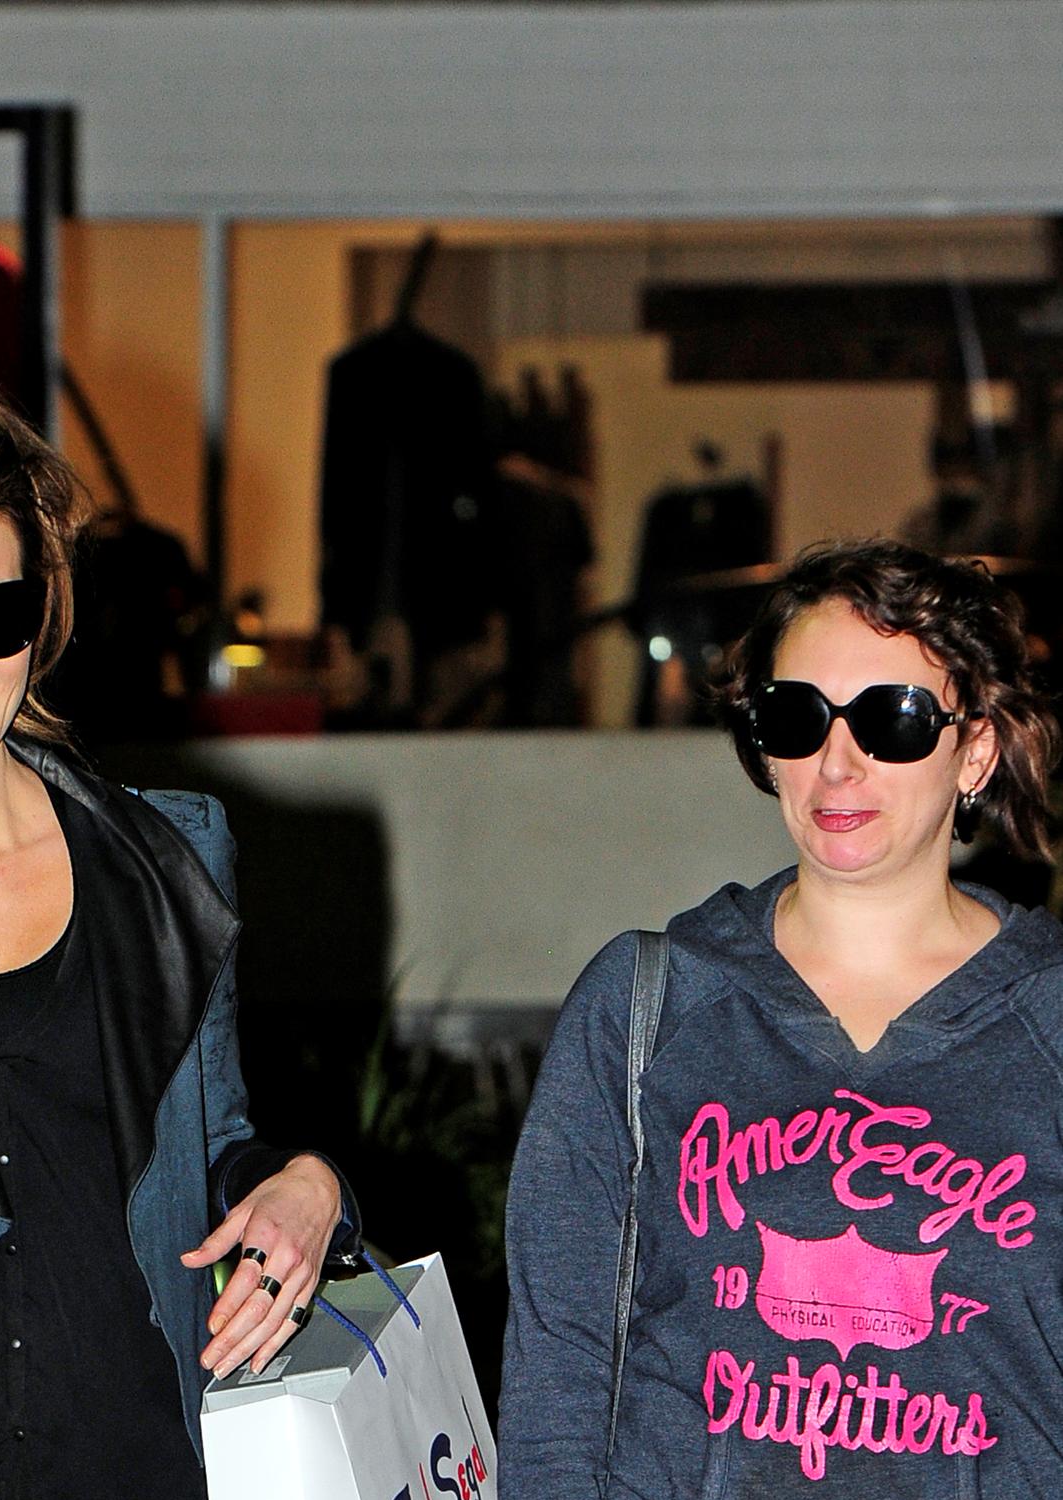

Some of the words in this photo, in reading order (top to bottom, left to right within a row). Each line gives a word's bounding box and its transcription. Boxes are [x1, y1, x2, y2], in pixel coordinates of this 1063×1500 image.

[711, 1263, 750, 1310] 19
[939, 1291, 990, 1335] 77
[771, 1305, 837, 1329] PHYSICAL
[851, 1315, 917, 1338] EDUCATION
[702, 1350, 999, 1481] Outfitters
